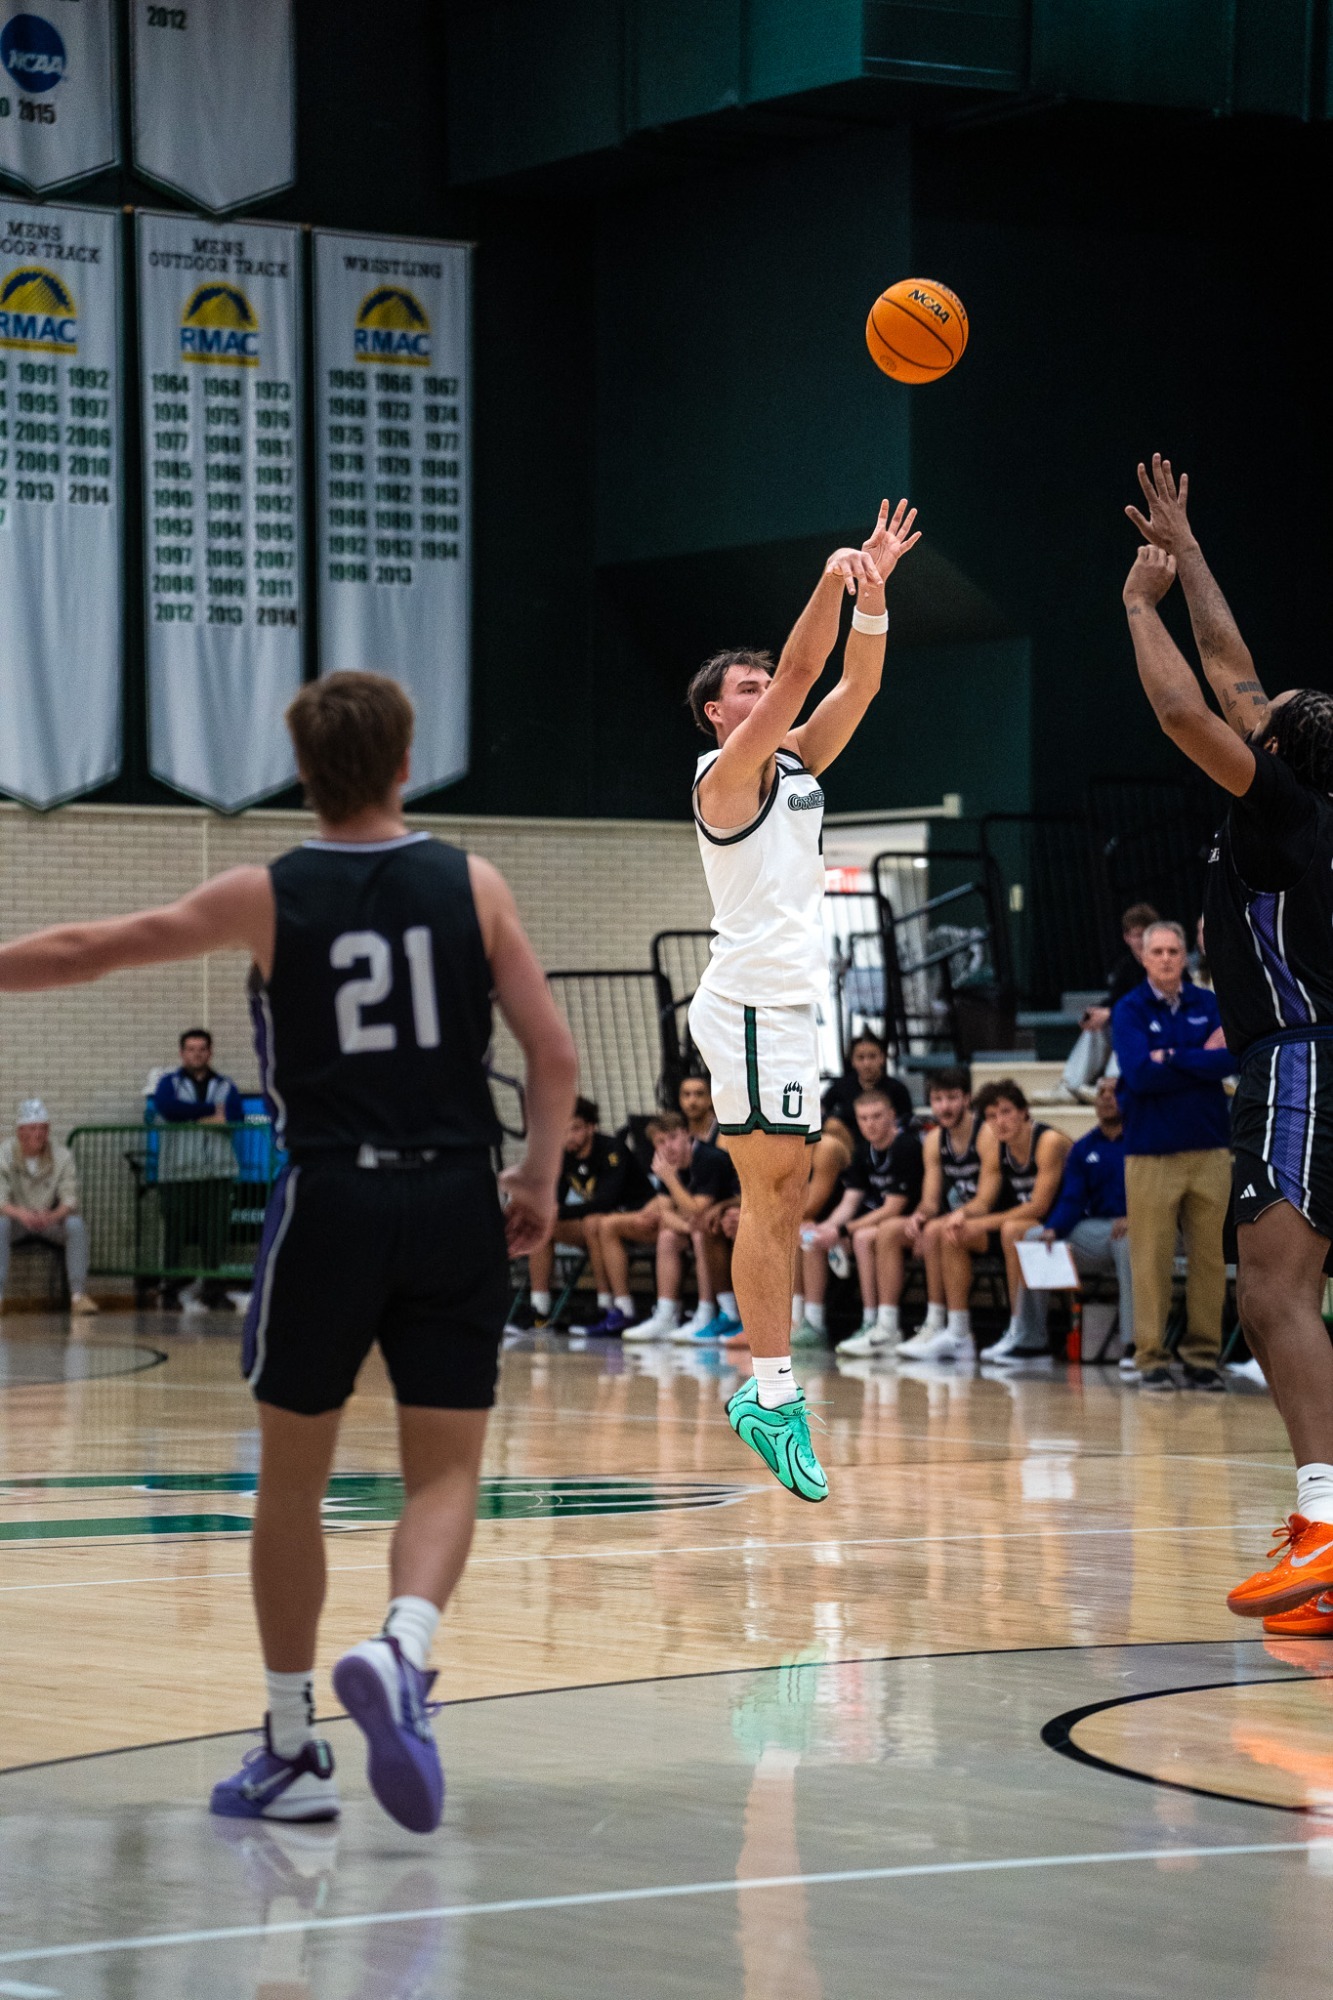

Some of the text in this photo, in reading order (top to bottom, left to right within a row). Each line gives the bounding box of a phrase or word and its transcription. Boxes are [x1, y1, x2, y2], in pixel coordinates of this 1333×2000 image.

[147, 6, 187, 30] 2012
[8, 49, 63, 74] NCAA
[18, 98, 56, 124] 2015
[7, 221, 62, 241] MENS
[43, 243, 100, 263] TRACK
[193, 238, 244, 256] MENS
[149, 251, 288, 278] OUTDOOR TRACK
[343, 256, 442, 279] WRESTLING
[908, 289, 950, 325] NCAA
[0, 313, 76, 343] RMAC
[180, 327, 258, 356] RMAC
[354, 329, 430, 356] RMAC
[18, 363, 109, 390] 1991 1992
[152, 373, 189, 395] 1964
[255, 381, 290, 401] 1973
[329, 370, 367, 390] 1965
[423, 376, 458, 396] 1967
[17, 393, 108, 419] 1995 1997
[154, 402, 188, 423] 1974
[205, 406, 240, 426] 1975
[377, 400, 410, 421] 1973
[424, 404, 458, 423] 1974
[15, 421, 111, 448] 2005 2006
[155, 431, 188, 452] 1977
[425, 431, 459, 451] 1977
[15, 451, 110, 477] 2009 2010
[16, 481, 109, 504] 2013 2014
[155, 546, 192, 566] 1997
[376, 565, 411, 585] 2013
[257, 578, 292, 598] 2011
[156, 603, 297, 627] 2012 2013 2014
[330, 926, 440, 1054] 21
